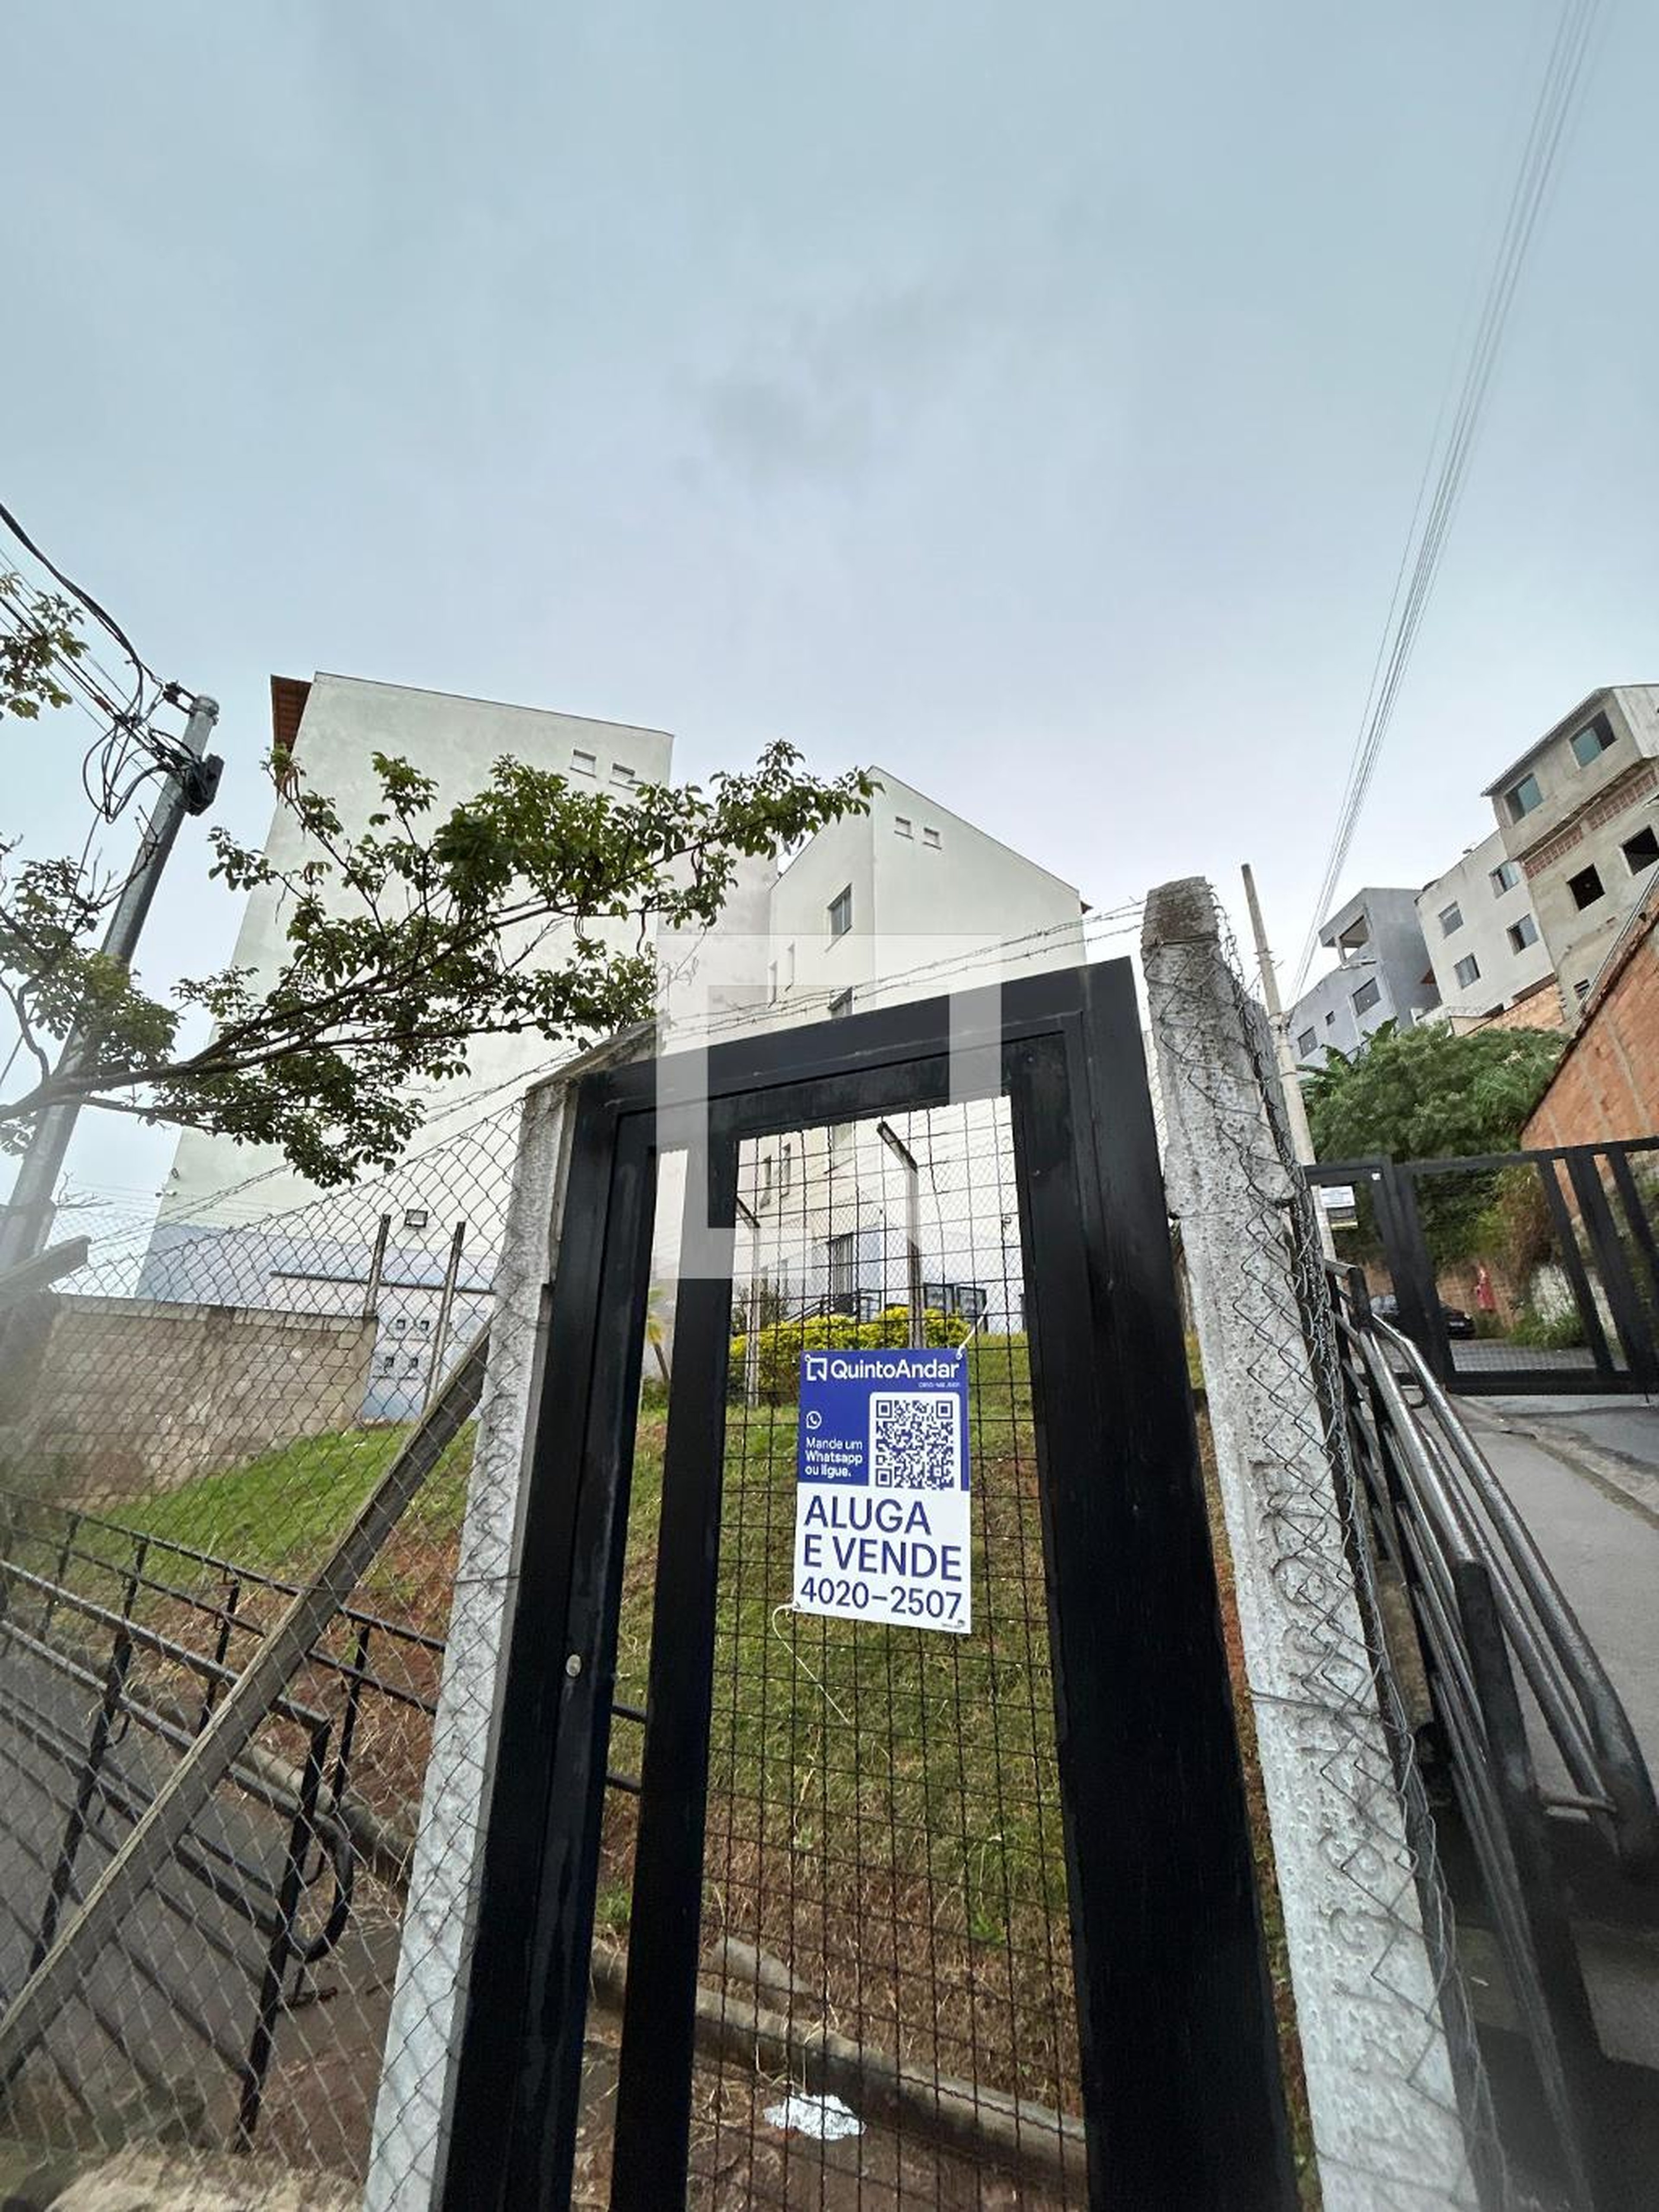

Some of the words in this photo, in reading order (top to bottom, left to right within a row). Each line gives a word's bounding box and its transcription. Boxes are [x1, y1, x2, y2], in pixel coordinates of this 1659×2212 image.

[830, 1359, 960, 1379] QuintoAndar
[806, 1436, 843, 1449] Mande
[845, 1440, 863, 1450] um
[805, 1450, 863, 1467] Whatsapp
[804, 1465, 819, 1475] ou
[821, 1463, 852, 1478] ligue.
[803, 1495, 932, 1535] ALUGA
[803, 1534, 823, 1568] E
[832, 1535, 962, 1582] VENDE
[800, 1576, 962, 1620] 4020-2507
